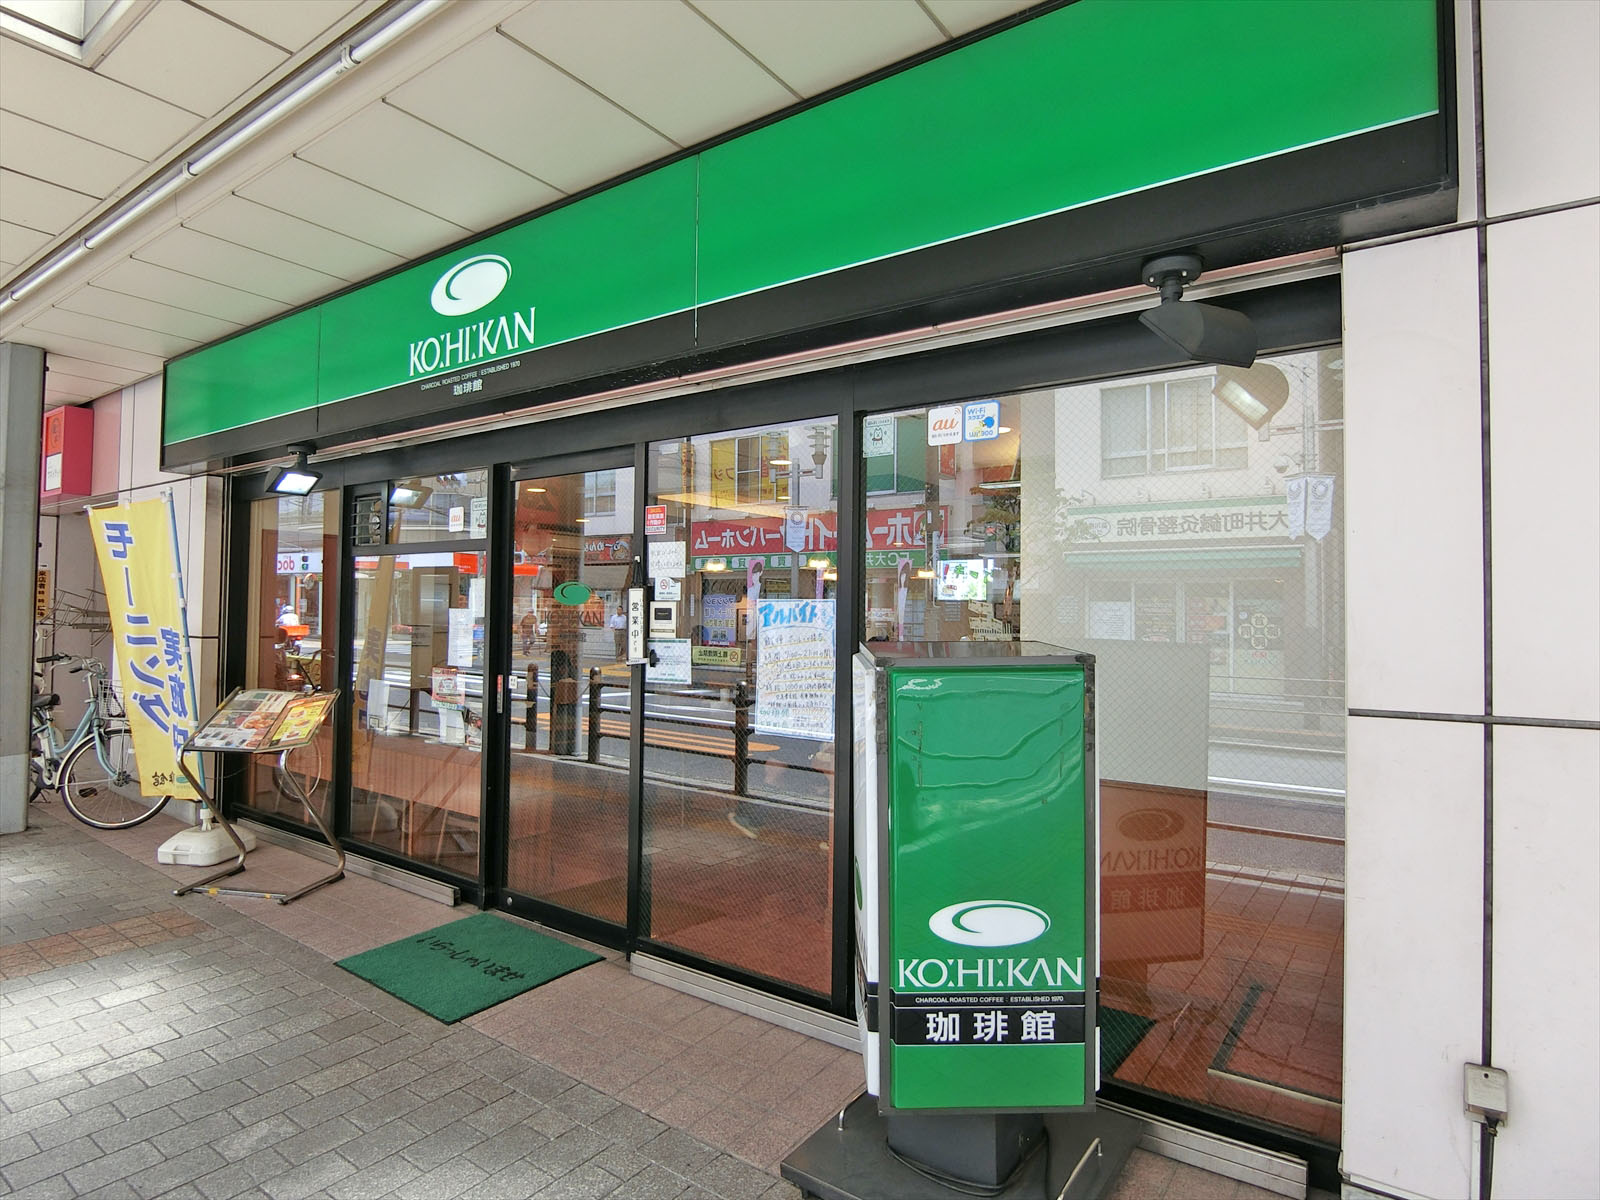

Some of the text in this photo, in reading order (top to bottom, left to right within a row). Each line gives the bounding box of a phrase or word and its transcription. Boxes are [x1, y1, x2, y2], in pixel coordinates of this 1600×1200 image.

[420, 380, 441, 391] CHARCOAL
[441, 375, 461, 385] ROASTED
[461, 370, 478, 381] COFFEE
[480, 363, 510, 376] ESTABLISHED
[453, 379, 483, 396] 珈琲館
[932, 417, 959, 431] au
[967, 406, 986, 415] Wi-Fi
[759, 601, 818, 628] アルバイト
[416, 935, 525, 982] いらっしゃいませ
[925, 1010, 1056, 1042] 珈琲館
